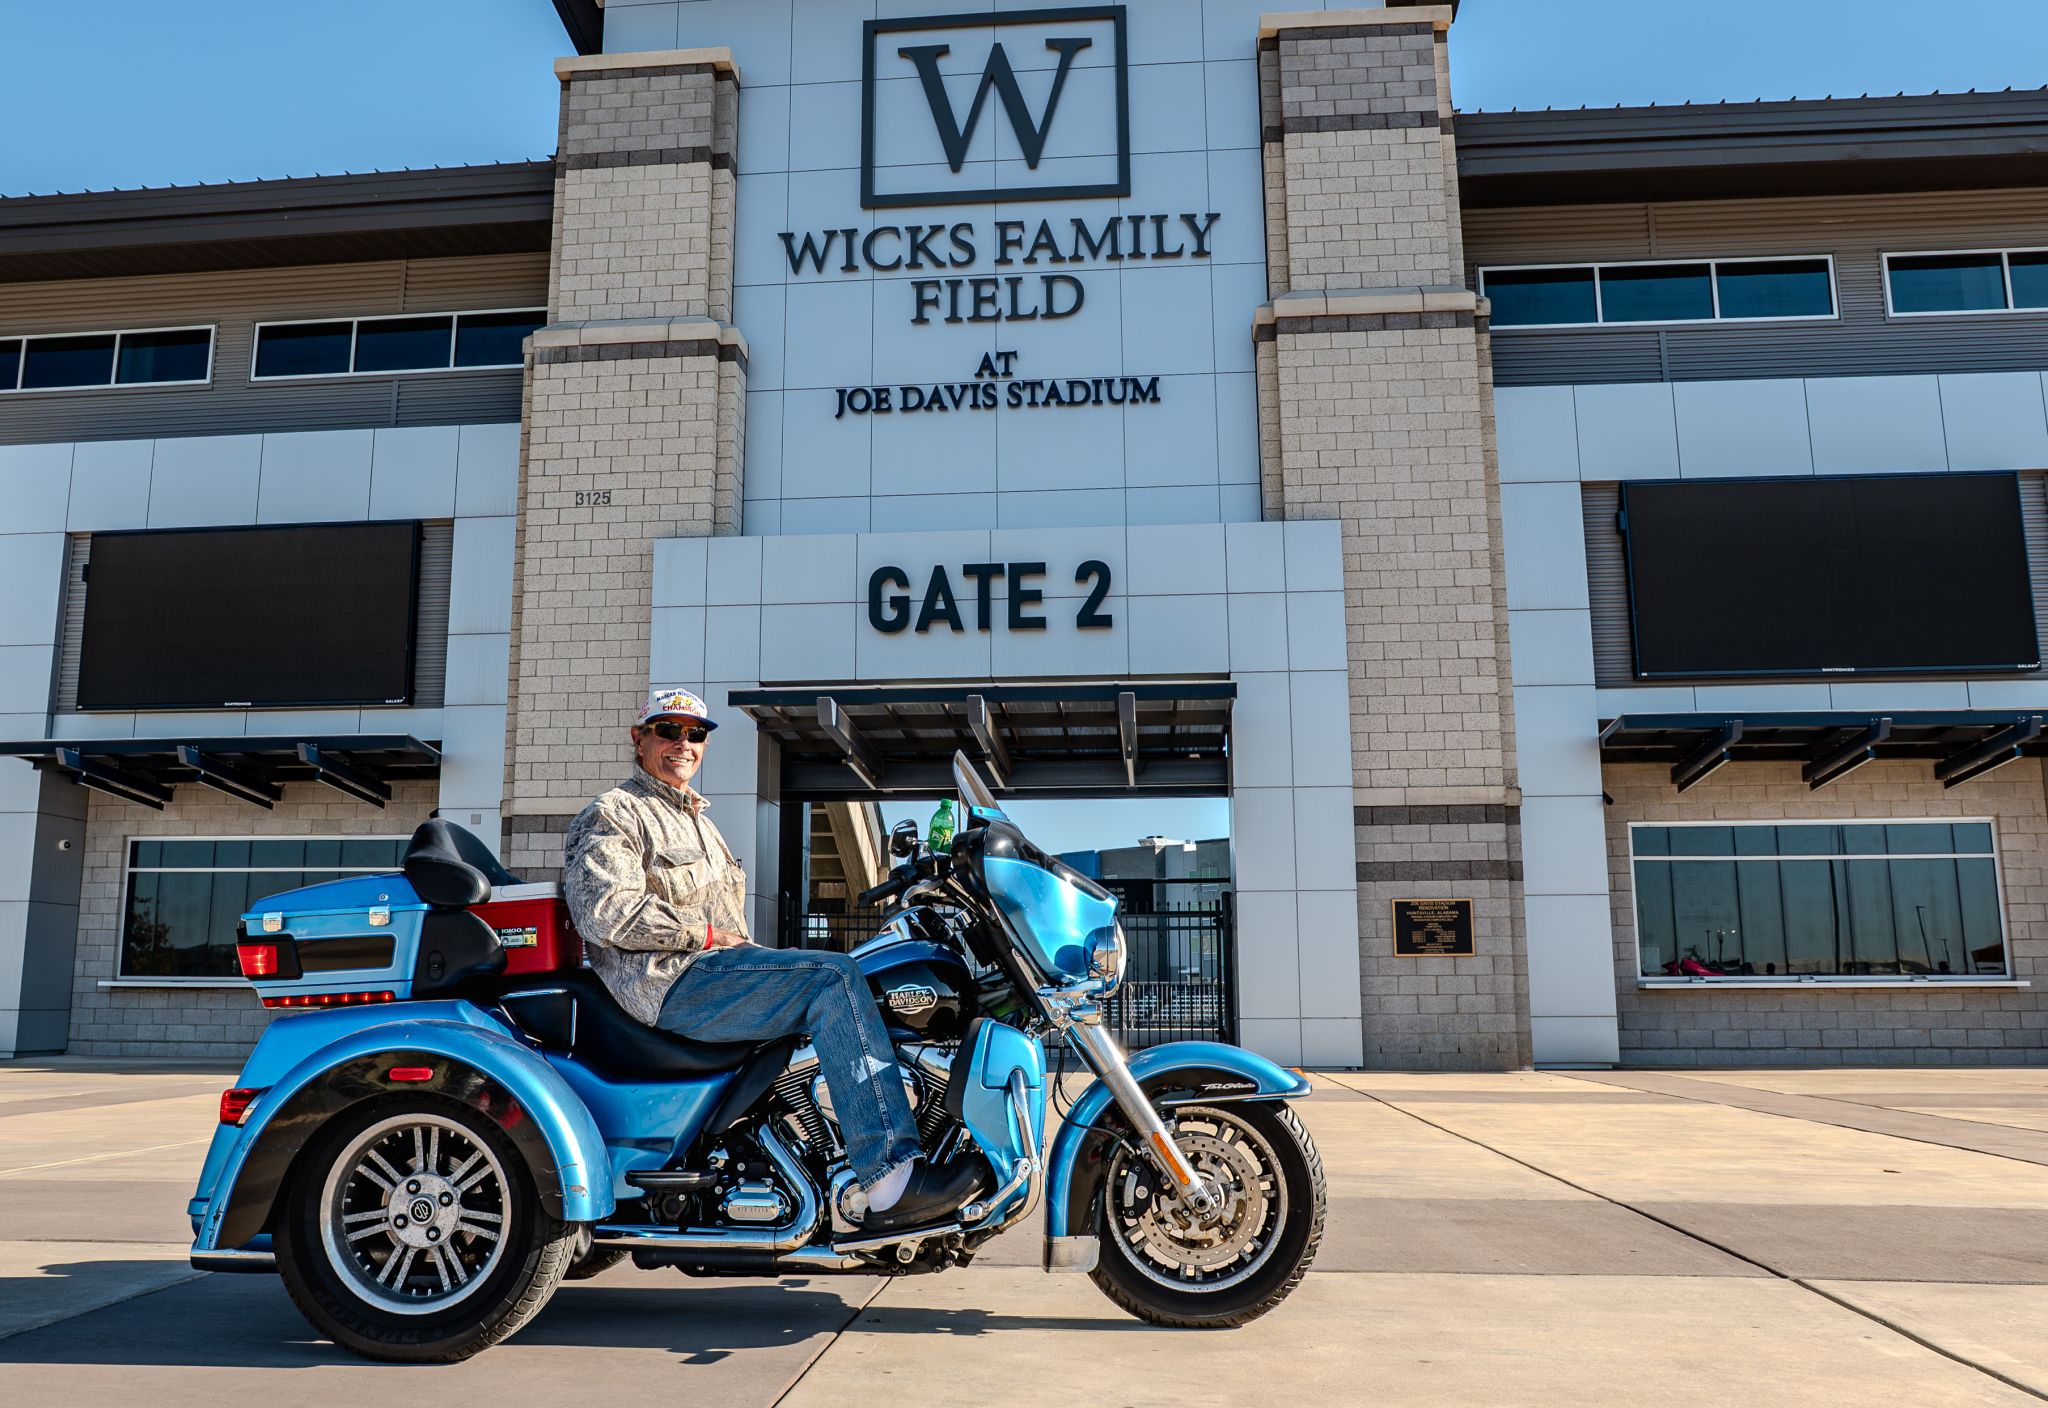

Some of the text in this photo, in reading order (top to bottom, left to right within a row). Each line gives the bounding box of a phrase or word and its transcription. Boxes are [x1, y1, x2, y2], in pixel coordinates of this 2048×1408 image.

[898, 37, 1092, 173] W
[777, 212, 1221, 275] WICKS FAMILY
[910, 275, 1085, 325] FIELD
[974, 350, 1018, 378] AT
[834, 376, 1161, 419] JOE DAVIS STADIUM
[576, 491, 610, 506] 3125
[868, 560, 1112, 633] GATE 2
[889, 995, 933, 1006] DAVIDSON
